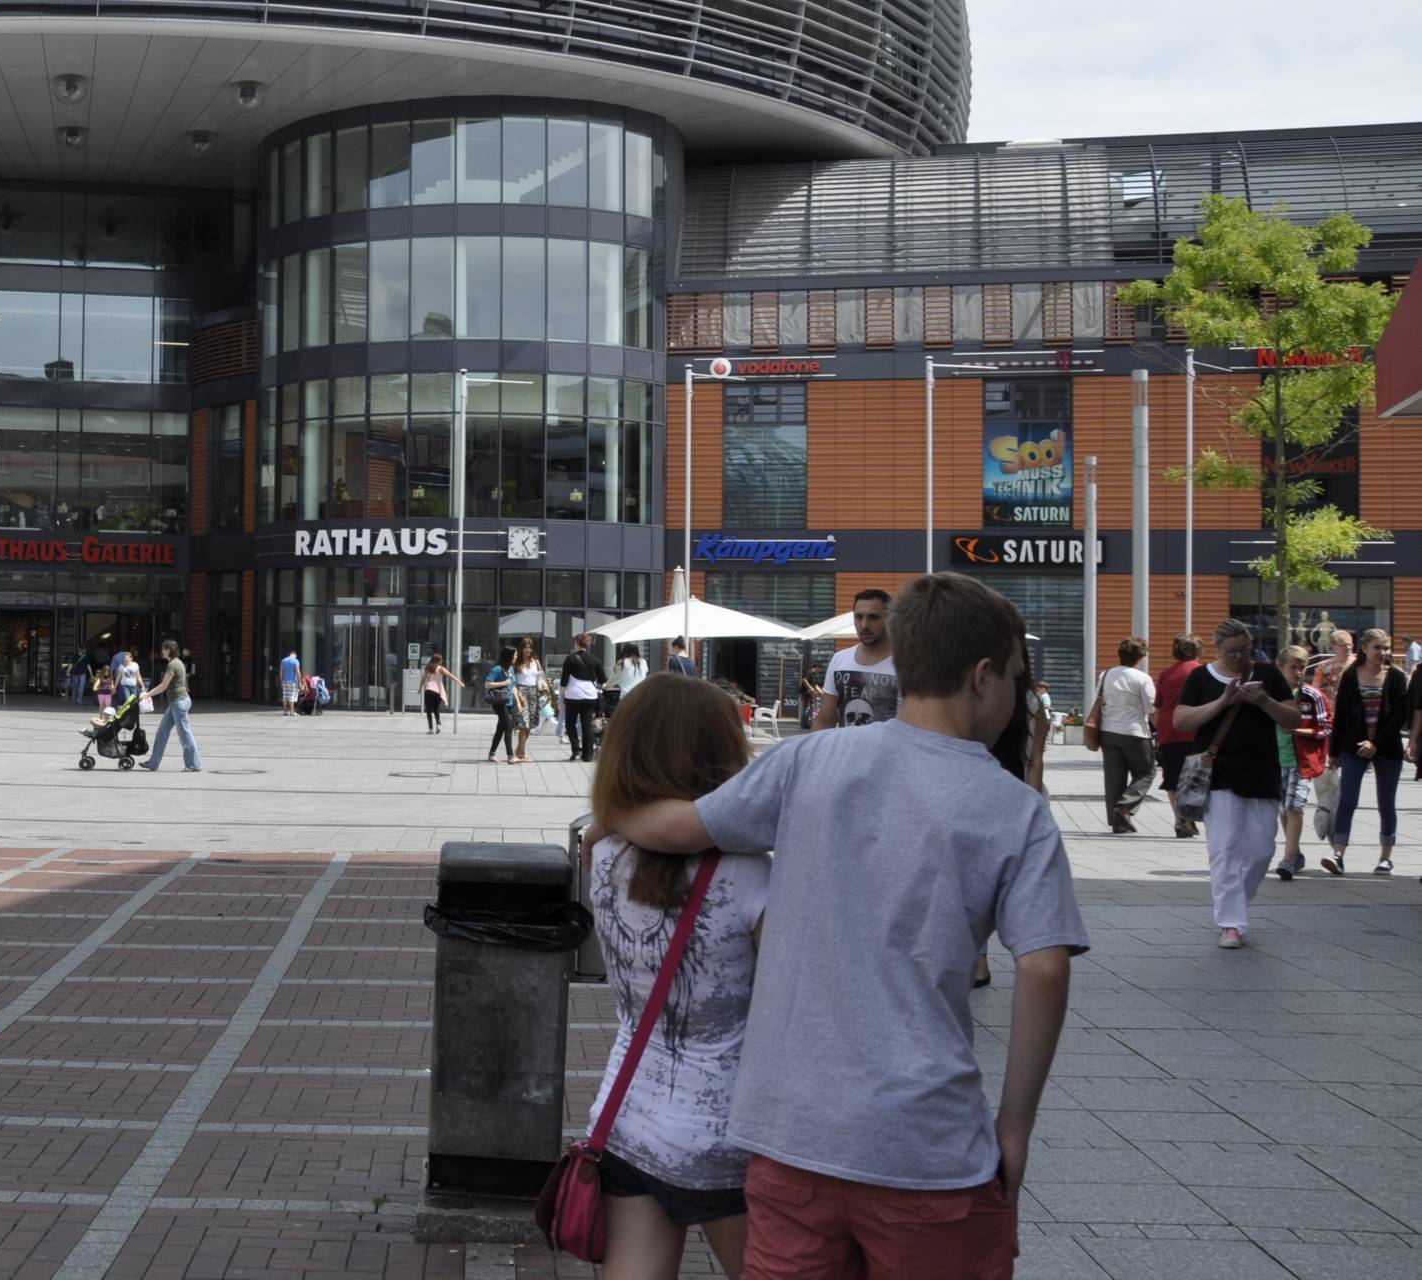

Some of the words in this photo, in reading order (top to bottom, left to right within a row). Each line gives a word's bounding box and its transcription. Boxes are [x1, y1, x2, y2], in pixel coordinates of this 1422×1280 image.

[738, 358, 819, 374] vodafone
[1018, 464, 1064, 480] MUSS
[993, 479, 1063, 494] TECHNIK
[1013, 507, 1070, 522] SATURN
[295, 528, 448, 556] RATHAUS
[693, 533, 835, 565] Kämpgen
[868, 673, 898, 688] NOT
[842, 684, 877, 699] FEAR
